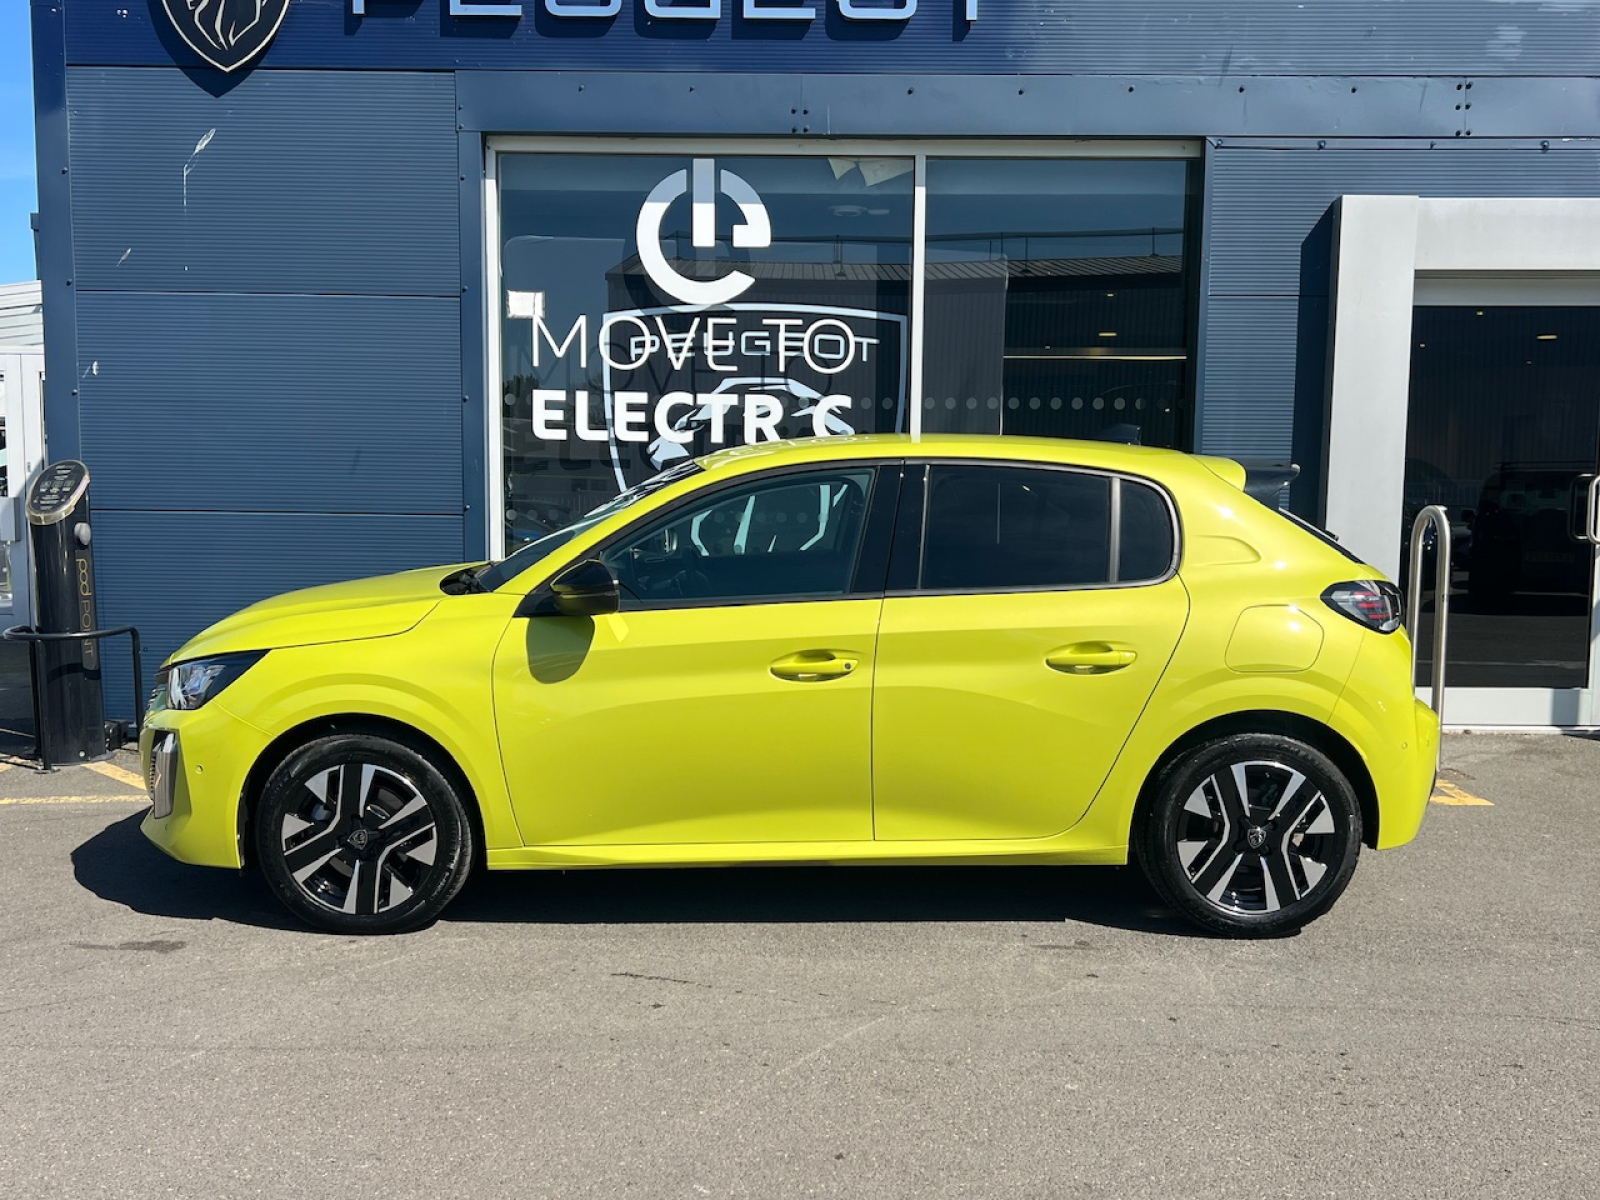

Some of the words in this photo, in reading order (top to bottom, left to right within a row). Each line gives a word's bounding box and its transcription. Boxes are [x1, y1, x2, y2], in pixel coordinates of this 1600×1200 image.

[531, 315, 738, 371] MOVE
[762, 317, 856, 374] TO
[630, 331, 880, 363] PEUGEOT
